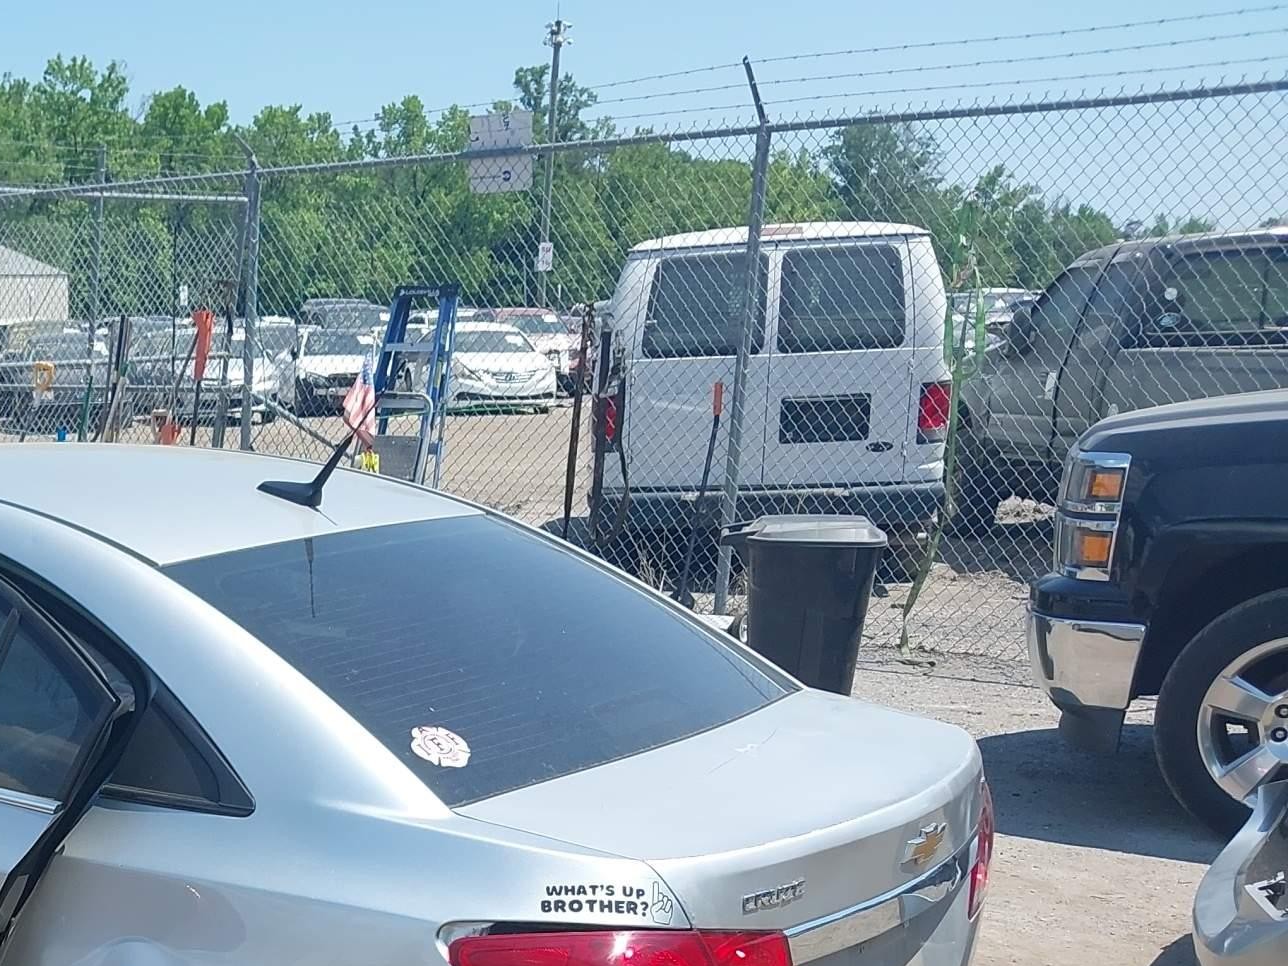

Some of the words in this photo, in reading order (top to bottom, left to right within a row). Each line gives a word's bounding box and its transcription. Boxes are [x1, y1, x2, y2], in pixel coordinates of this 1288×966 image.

[545, 884, 615, 897] WHAT'S
[622, 885, 646, 900] UP
[540, 899, 649, 917] BROTHER?
